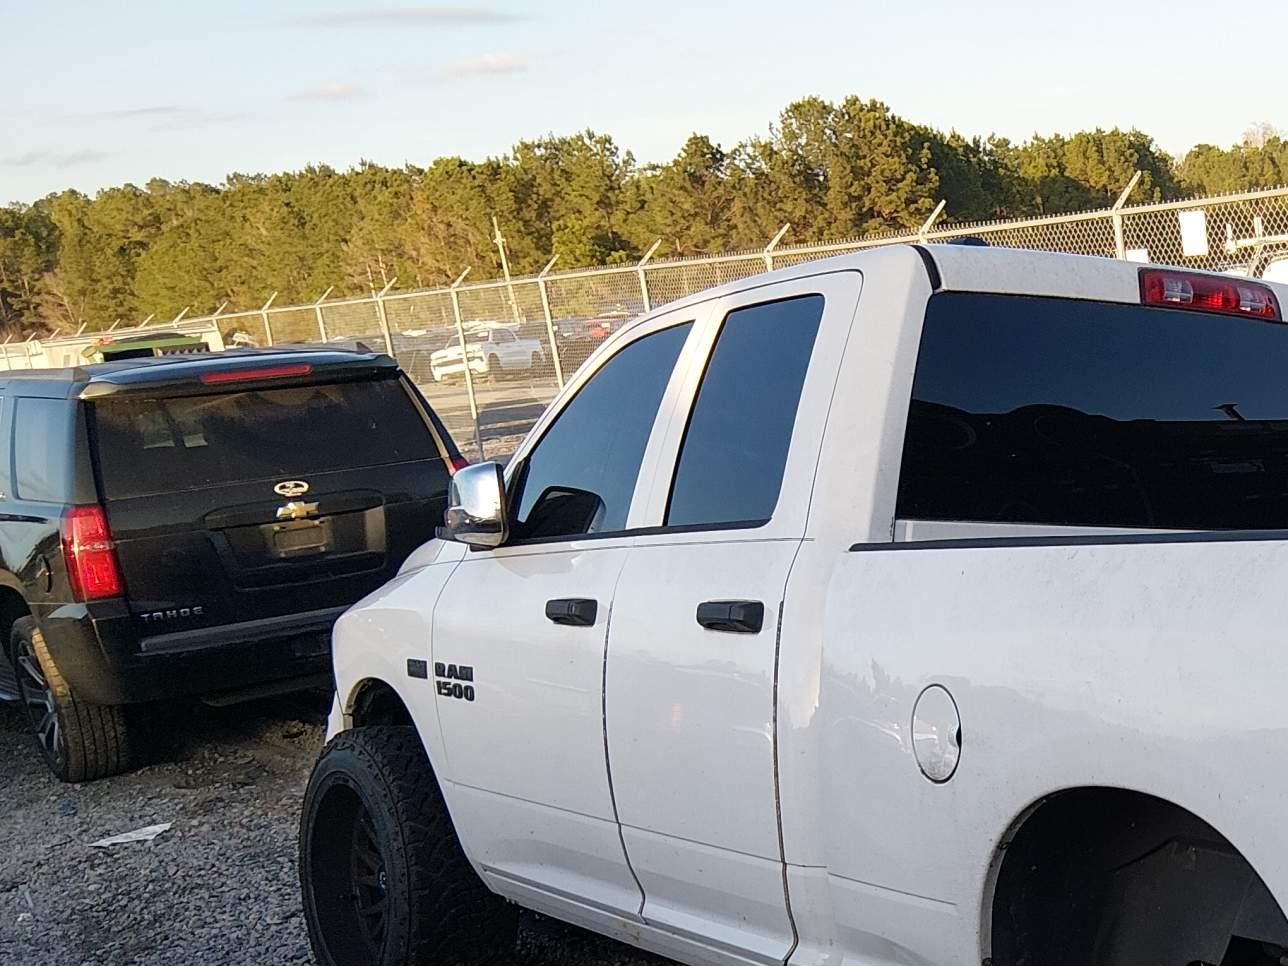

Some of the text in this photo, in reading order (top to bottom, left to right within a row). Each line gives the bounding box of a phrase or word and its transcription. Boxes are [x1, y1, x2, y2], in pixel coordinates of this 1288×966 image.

[139, 605, 203, 622] TAHOE
[434, 661, 474, 682] RAM
[435, 680, 475, 702] 1500
